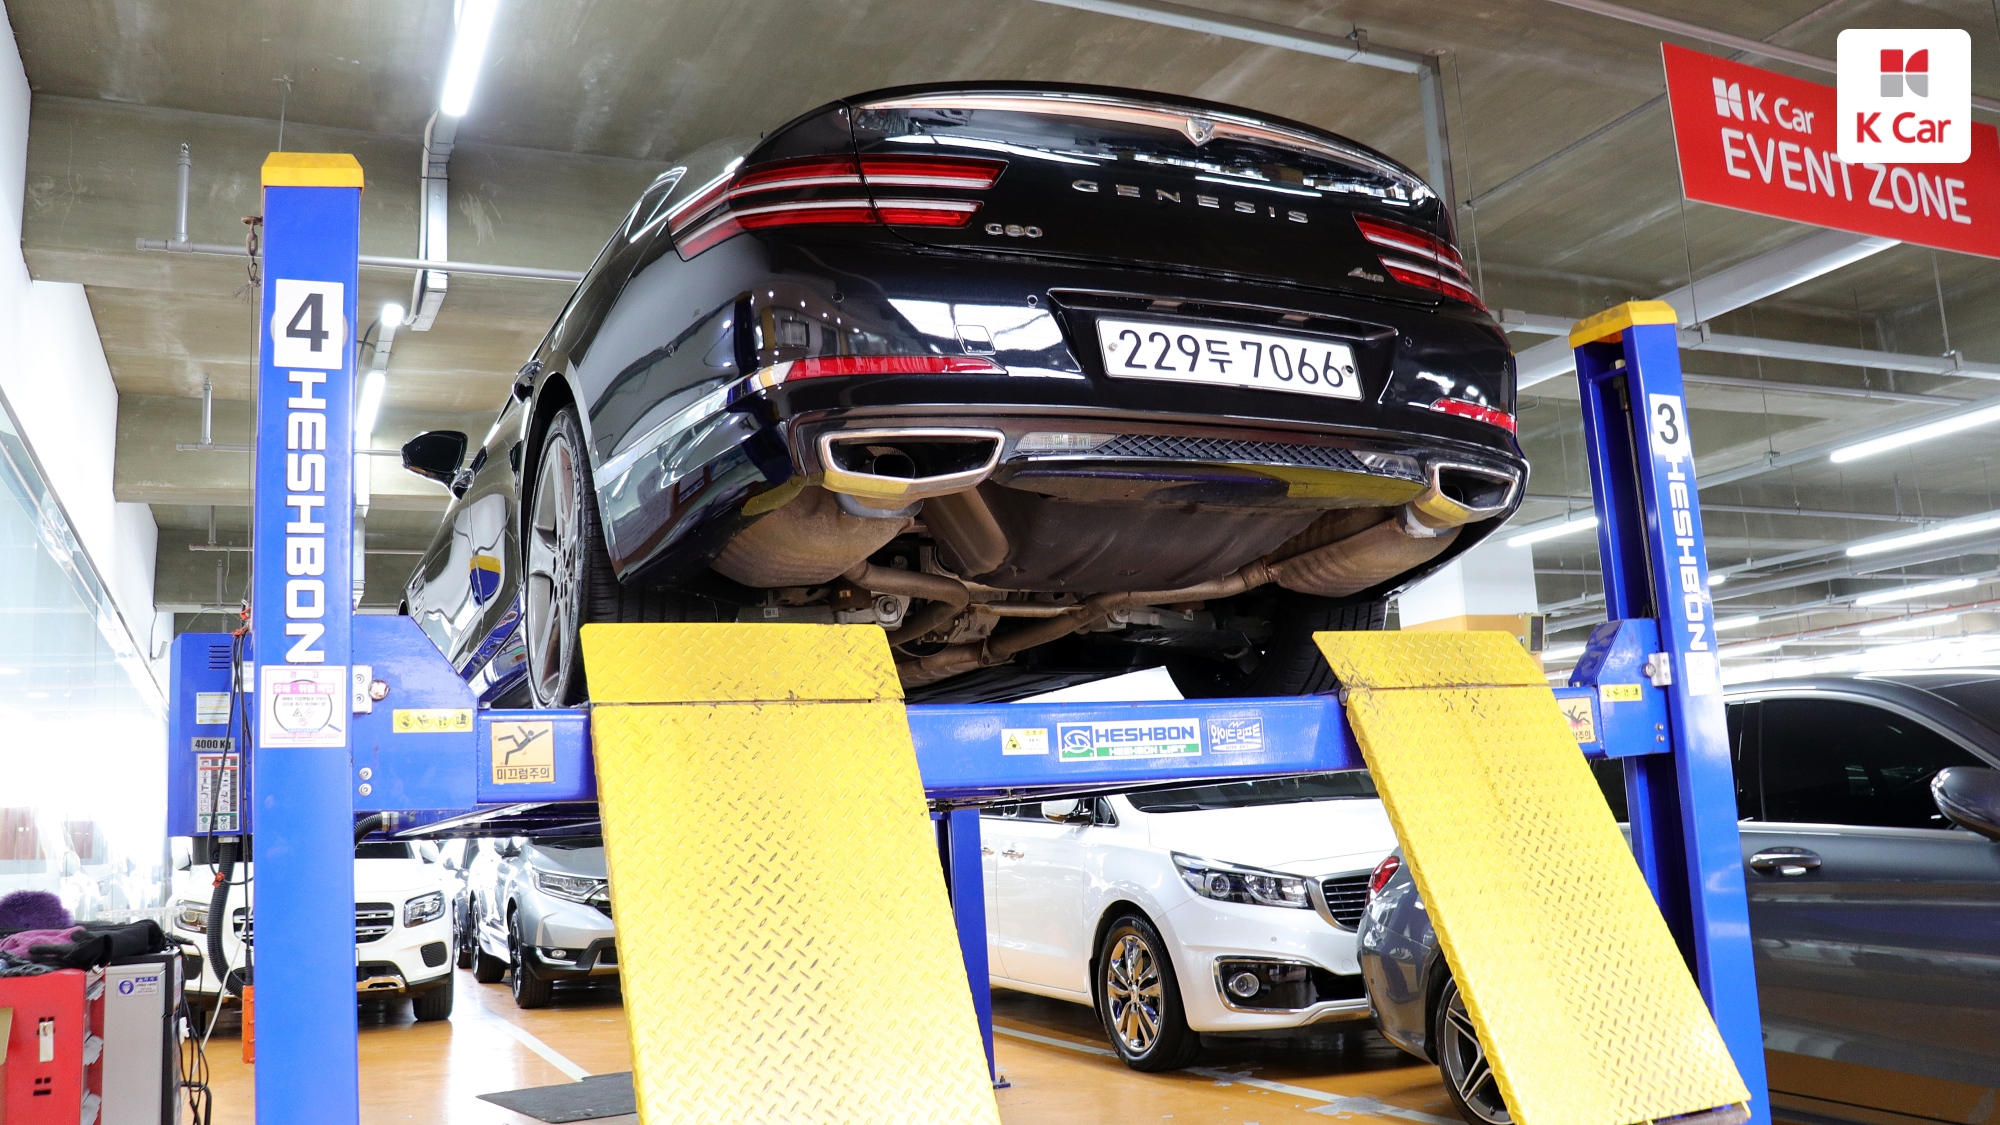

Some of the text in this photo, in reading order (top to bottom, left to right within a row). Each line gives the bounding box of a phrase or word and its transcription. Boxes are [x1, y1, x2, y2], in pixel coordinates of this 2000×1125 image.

[1747, 89, 1815, 135] K Car
[1721, 127, 1972, 225] EVENT ZONE
[1072, 179, 1309, 223] GENESIS
[985, 223, 1043, 239] G80
[286, 293, 329, 353] 4
[1657, 403, 1679, 445] 3
[285, 370, 327, 664] HESHBON
[1664, 455, 1709, 651] HESHBON
[195, 739, 218, 749] 4000
[1095, 726, 1195, 743] HESHBON
[1109, 744, 1187, 757] HESHBON LIFT
[1211, 722, 1262, 745] 와이드리프트
[497, 767, 550, 780] 미끄럼주의
